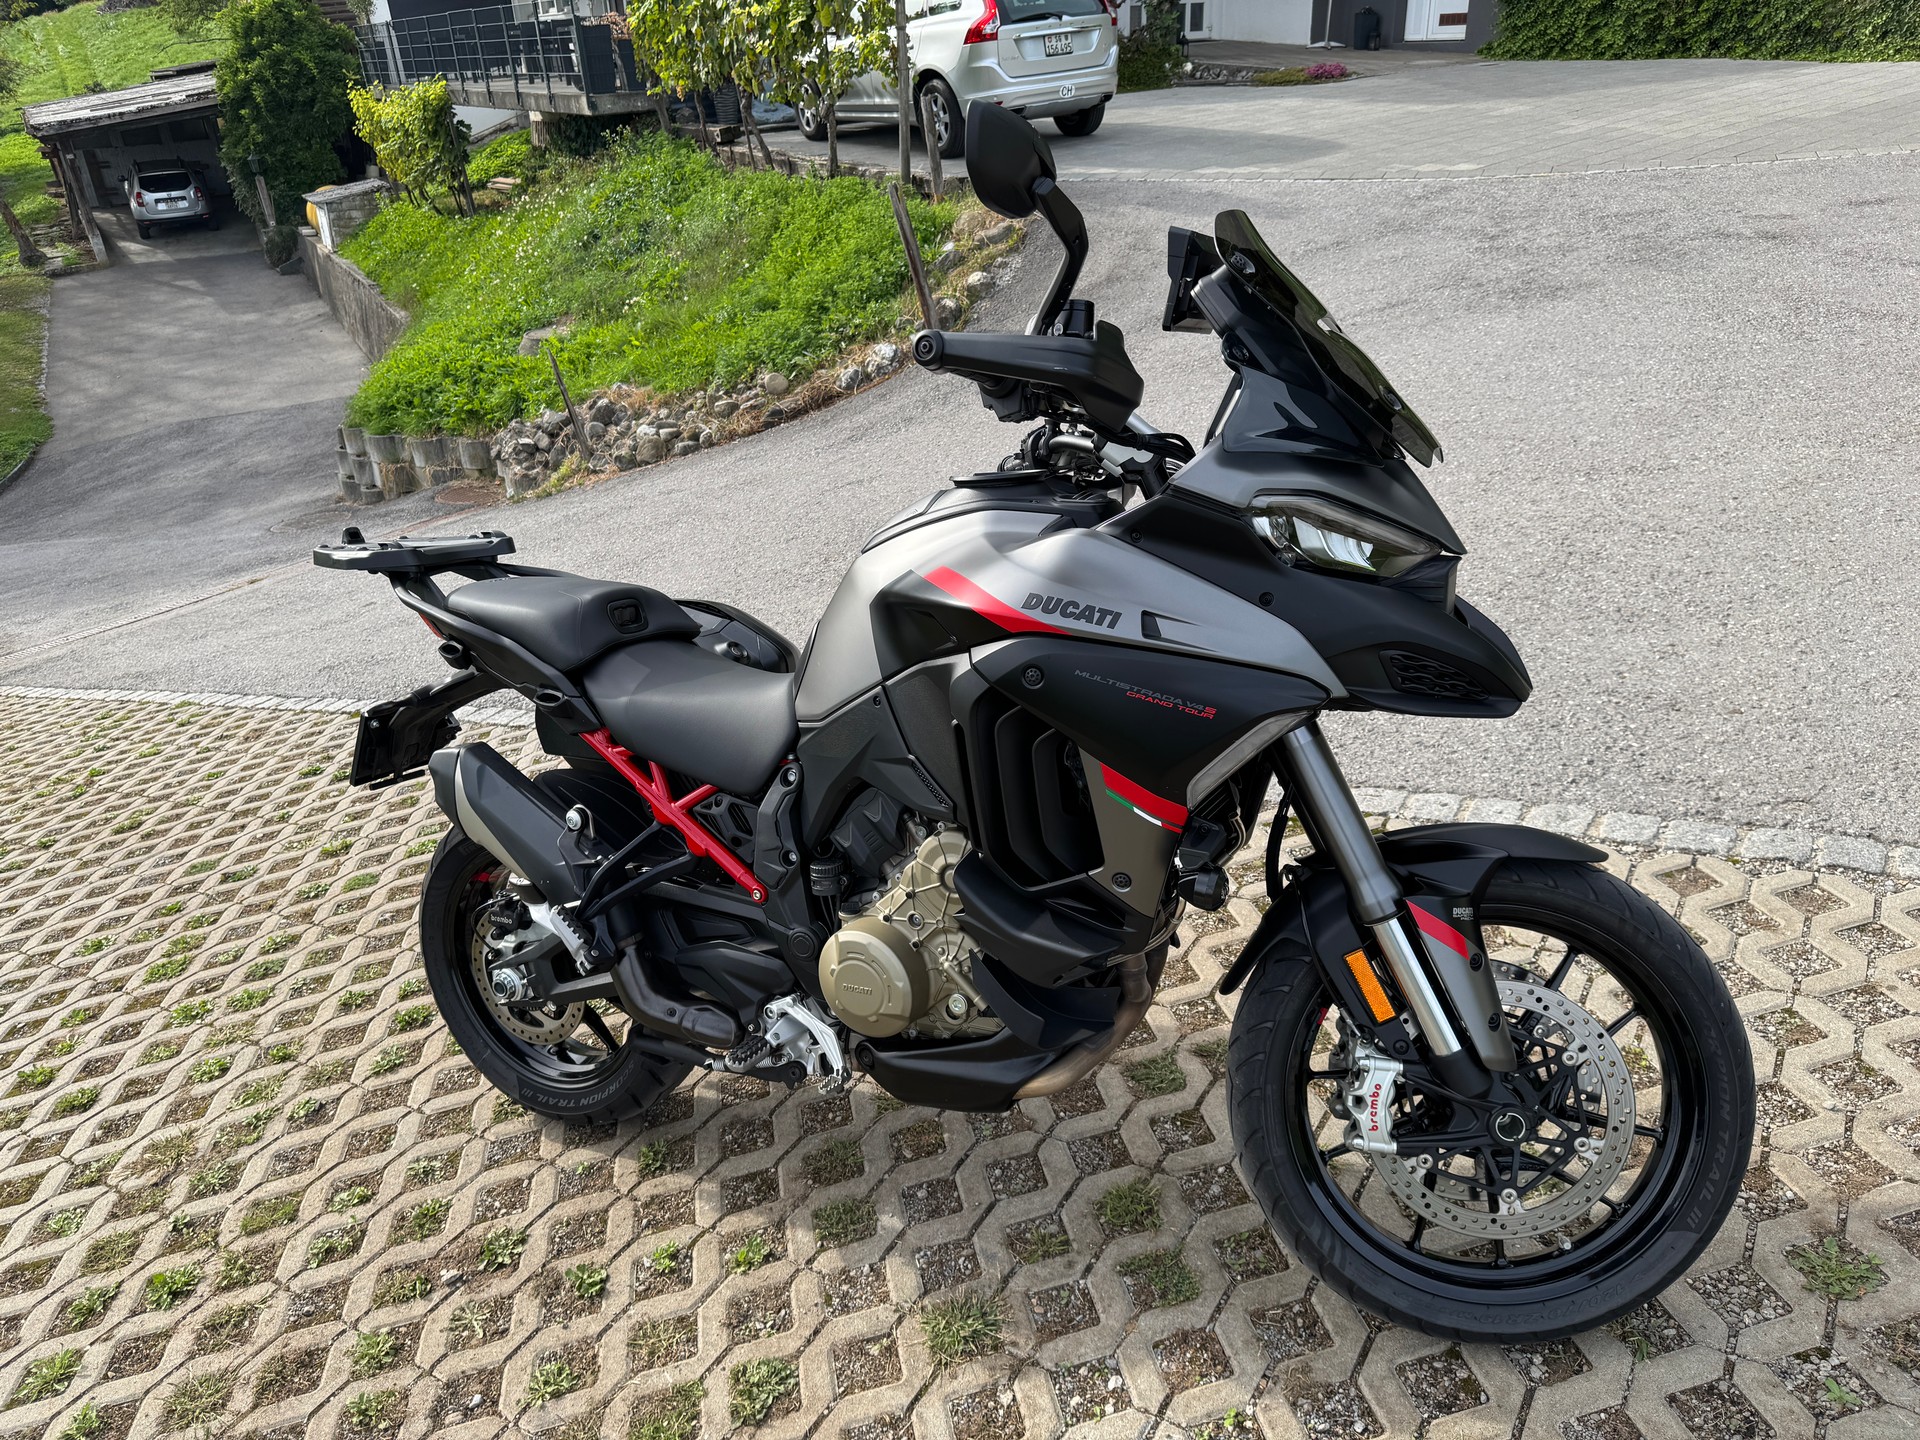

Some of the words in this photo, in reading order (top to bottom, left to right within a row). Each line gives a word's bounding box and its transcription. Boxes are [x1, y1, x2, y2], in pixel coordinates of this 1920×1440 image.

[1061, 85, 1073, 97] CH
[1020, 592, 1123, 630] DUCATI
[1074, 669, 1184, 706] MULTISTRADA
[1125, 690, 1174, 709] GRAND
[1176, 704, 1215, 720] TOUR
[490, 914, 513, 925] brembo
[842, 983, 873, 995] DUCATI
[579, 1059, 635, 1107] SCORPION
[536, 1093, 576, 1108] TRAIL
[1368, 1083, 1382, 1132] brembo
[1698, 1129, 1730, 1204] TRAIL
